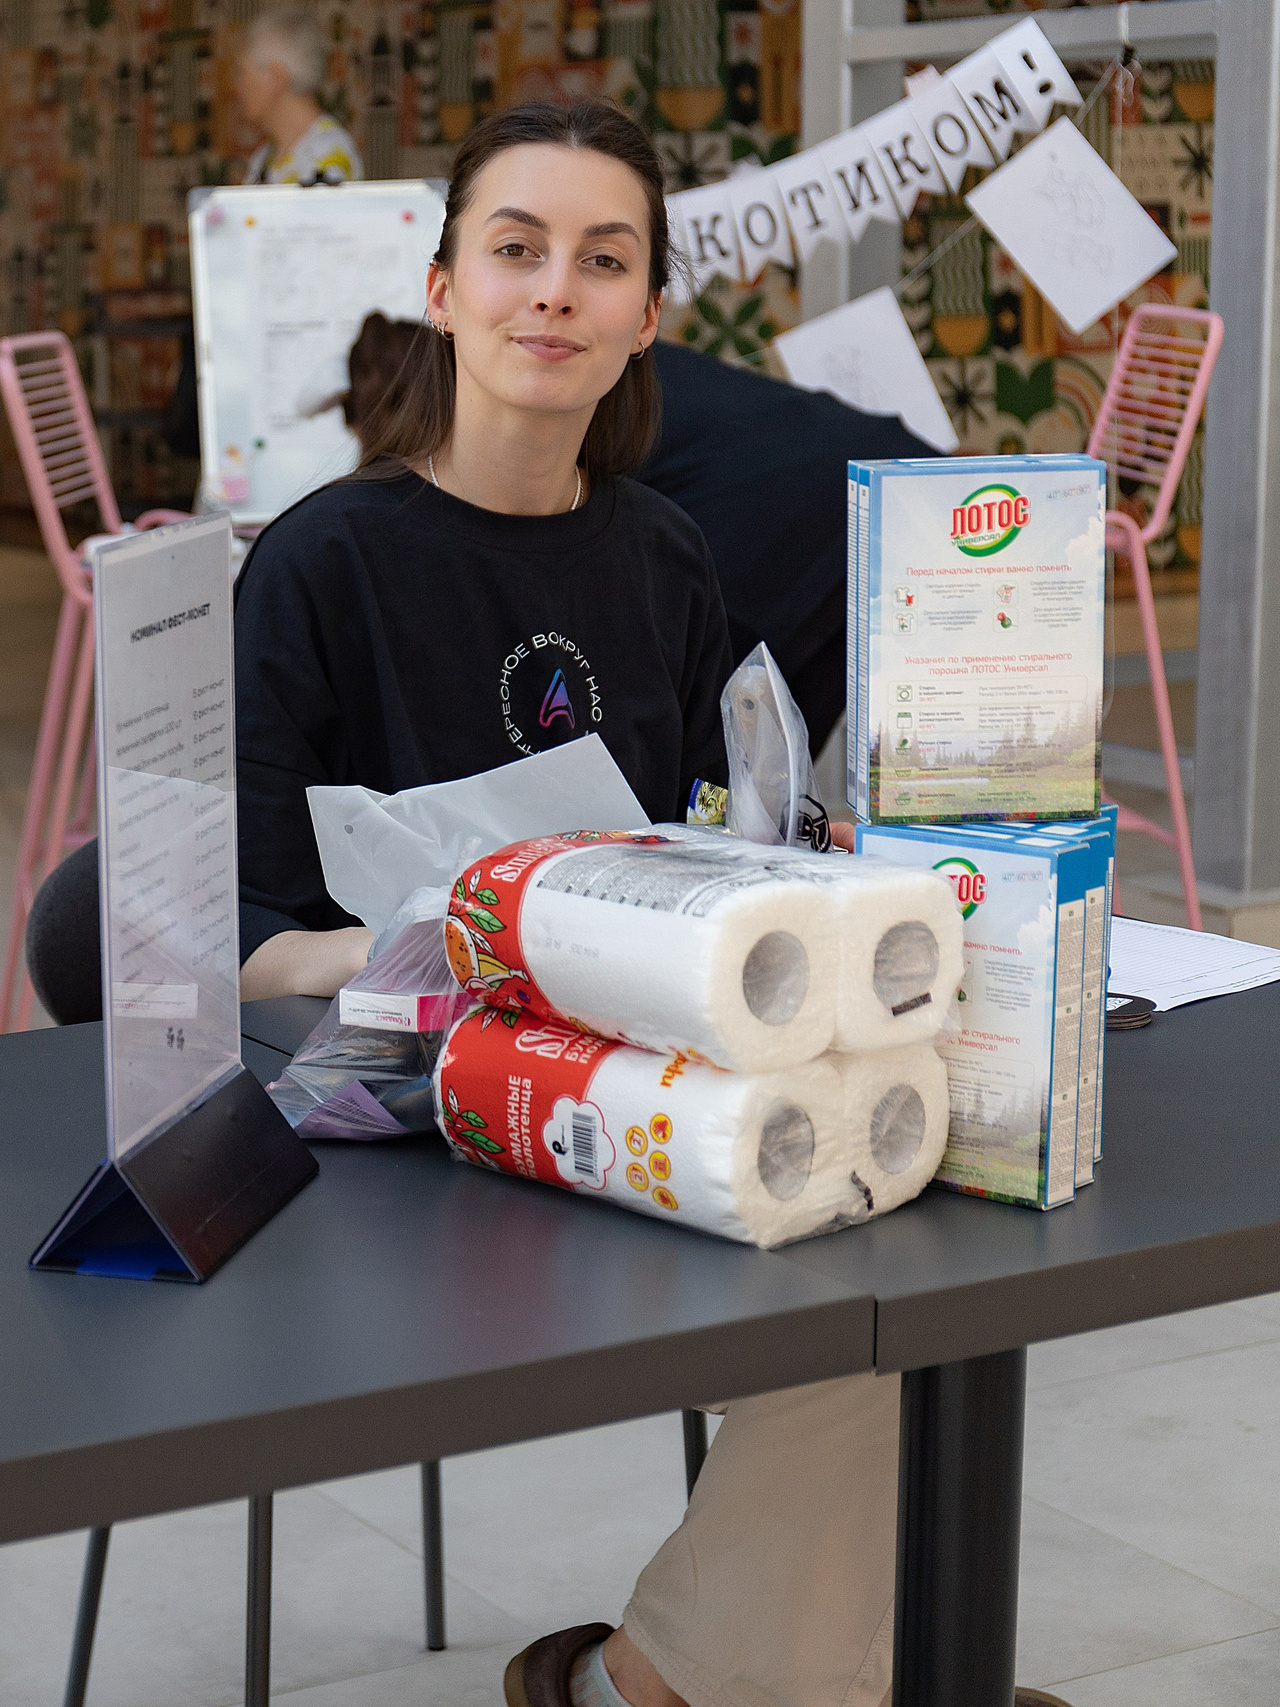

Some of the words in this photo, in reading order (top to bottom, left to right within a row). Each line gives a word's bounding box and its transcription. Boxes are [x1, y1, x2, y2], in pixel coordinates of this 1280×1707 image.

[691, 49, 1057, 263] КОТИКОМ!
[951, 495, 1032, 539] ЛОТОС
[951, 532, 1001, 547] УНИВЕРСАЛ
[906, 566, 934, 577] Перед
[936, 566, 973, 576] началом
[975, 566, 1004, 576] стирки
[1006, 565, 1034, 573] важно
[1036, 564, 1072, 573] помнить
[905, 655, 946, 665] Указания
[948, 656, 959, 664] по
[961, 654, 1017, 666] применению
[1019, 652, 1073, 663] стирального
[531, 631, 591, 670] ВОКРУГ
[585, 675, 602, 722] НАО
[929, 666, 969, 676] порошка
[971, 665, 1001, 674] ЛОТОС
[1003, 663, 1049, 675] Универсал
[989, 944, 1023, 956] помнить
[957, 1037, 999, 1052] Универсал
[971, 1030, 1021, 1045] стирального
[507, 1074, 529, 1177] БУМАЖНЫЕ
[521, 1077, 538, 1179] полотенца
